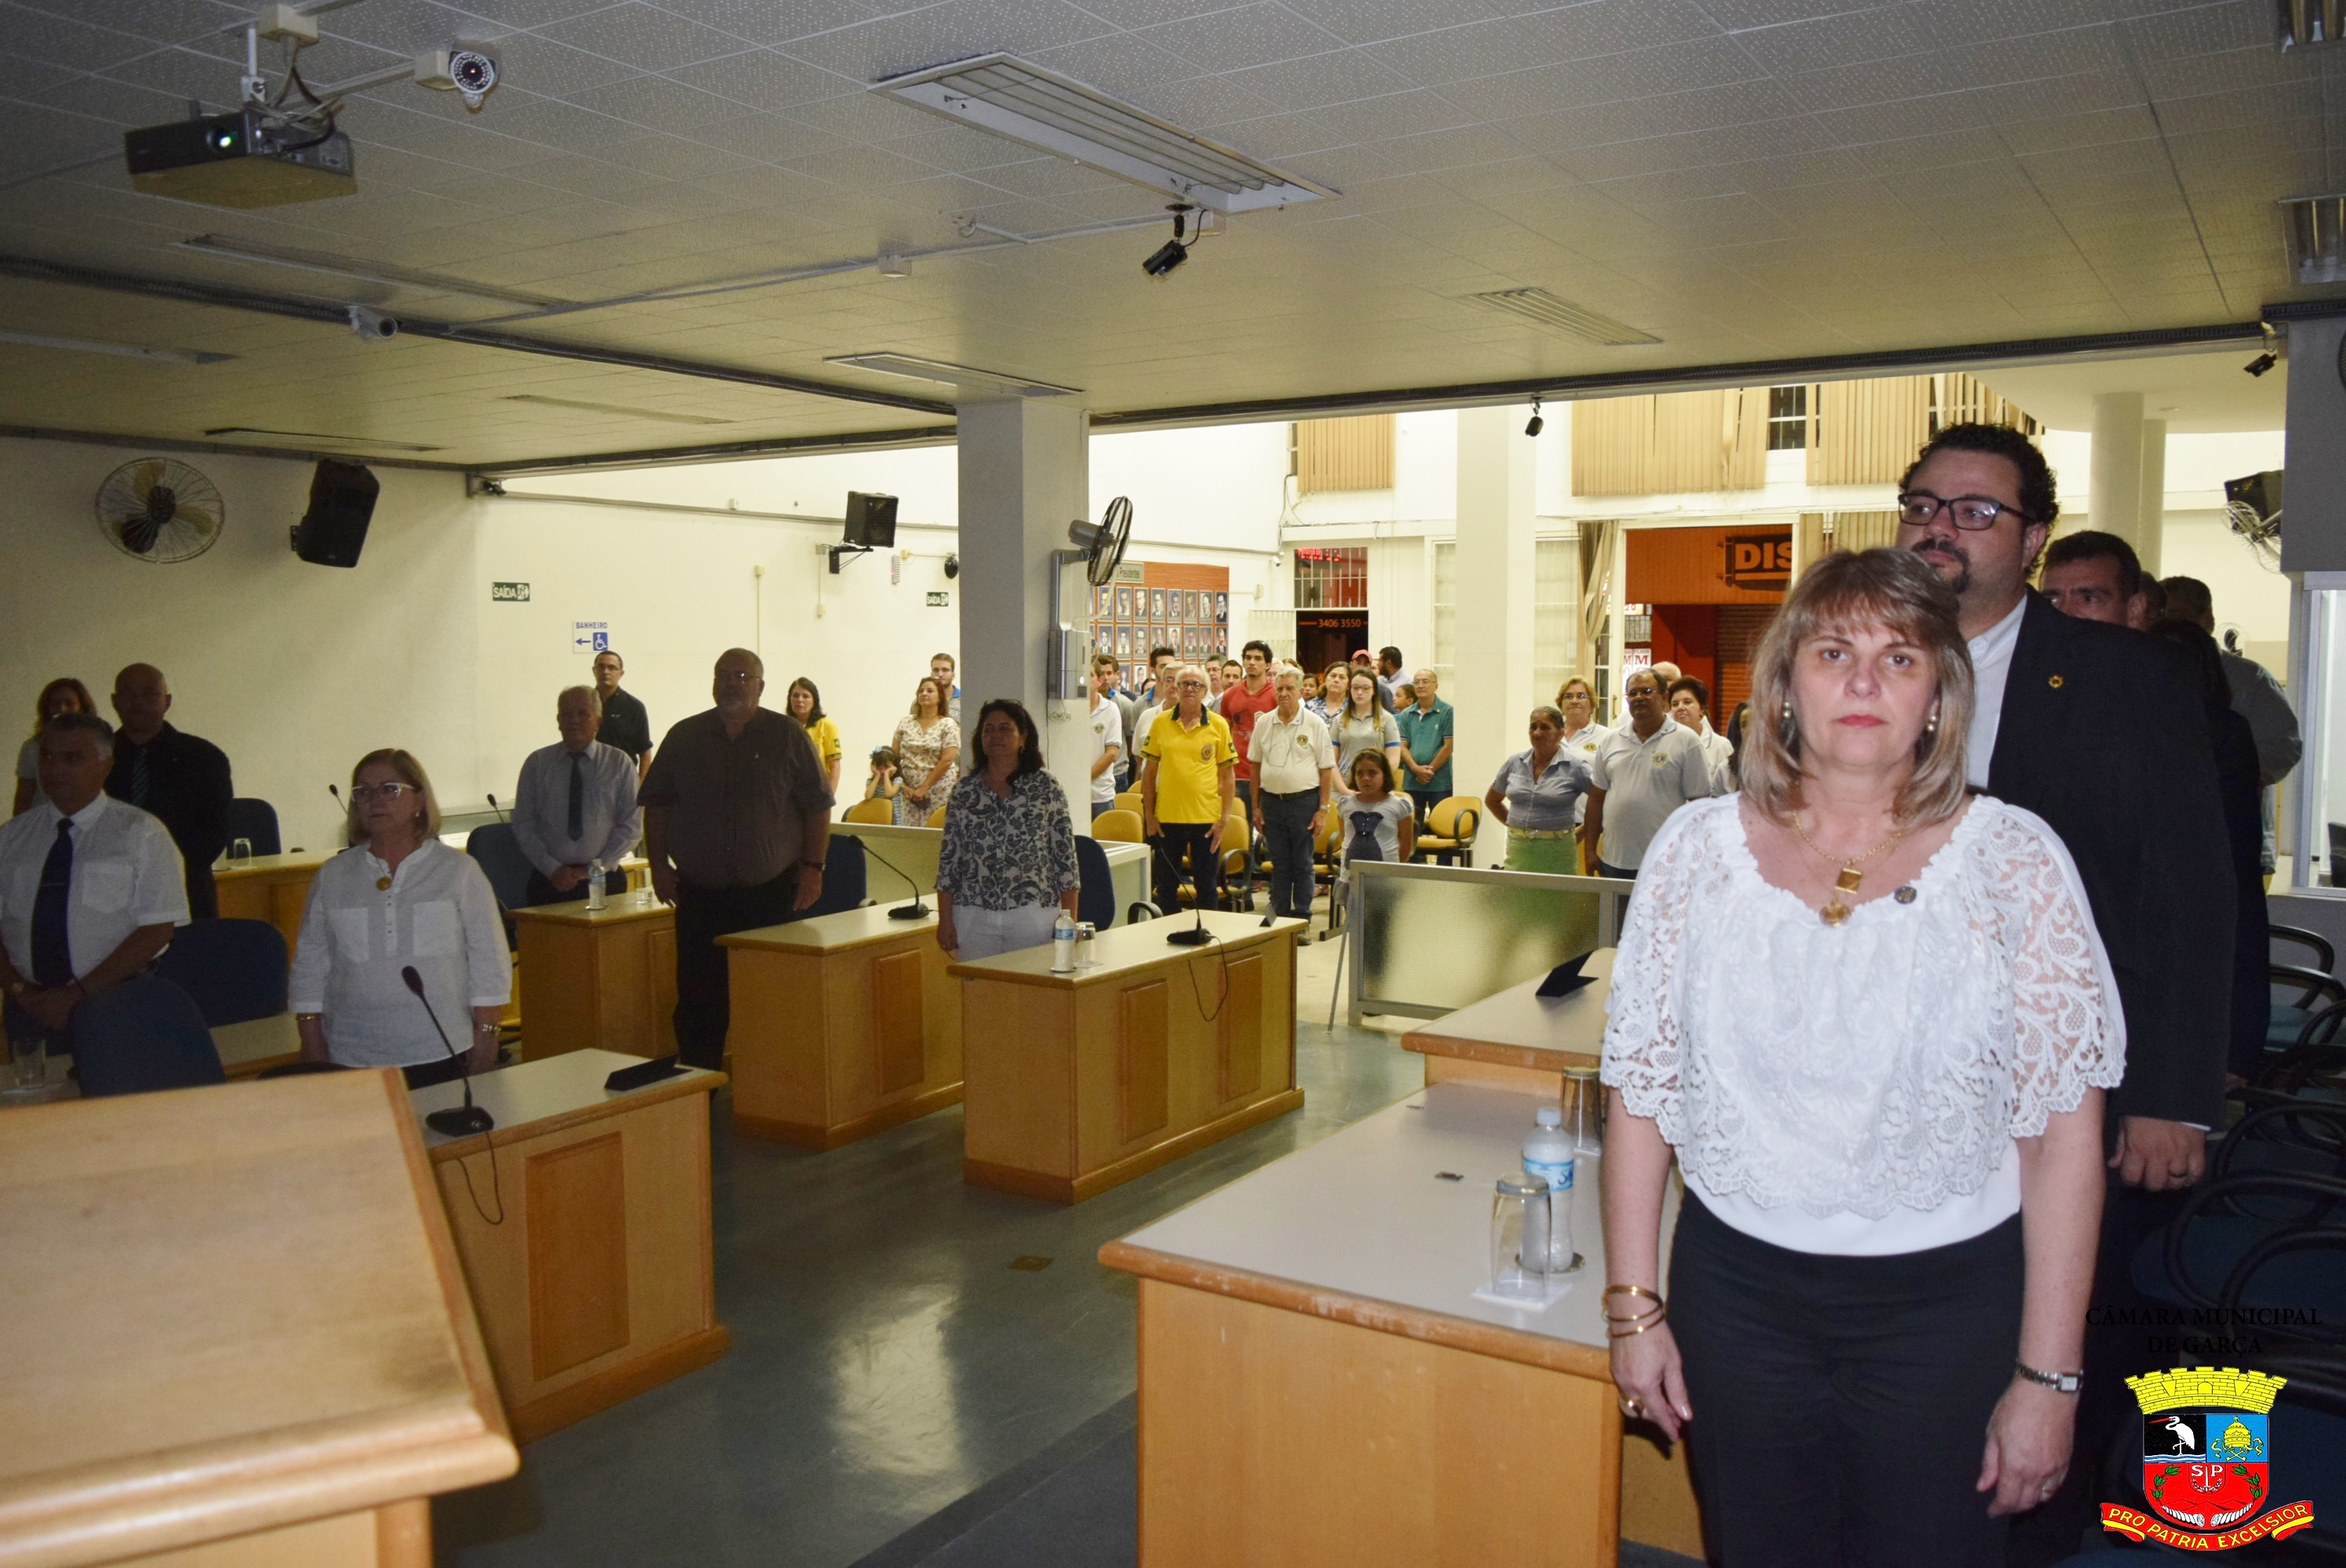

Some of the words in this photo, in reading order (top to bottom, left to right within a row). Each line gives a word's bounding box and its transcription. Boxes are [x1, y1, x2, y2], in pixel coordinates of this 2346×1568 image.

[492, 584, 517, 598] SAÍDA
[1318, 619, 1339, 628] 3406
[1341, 619, 1361, 627] 3550
